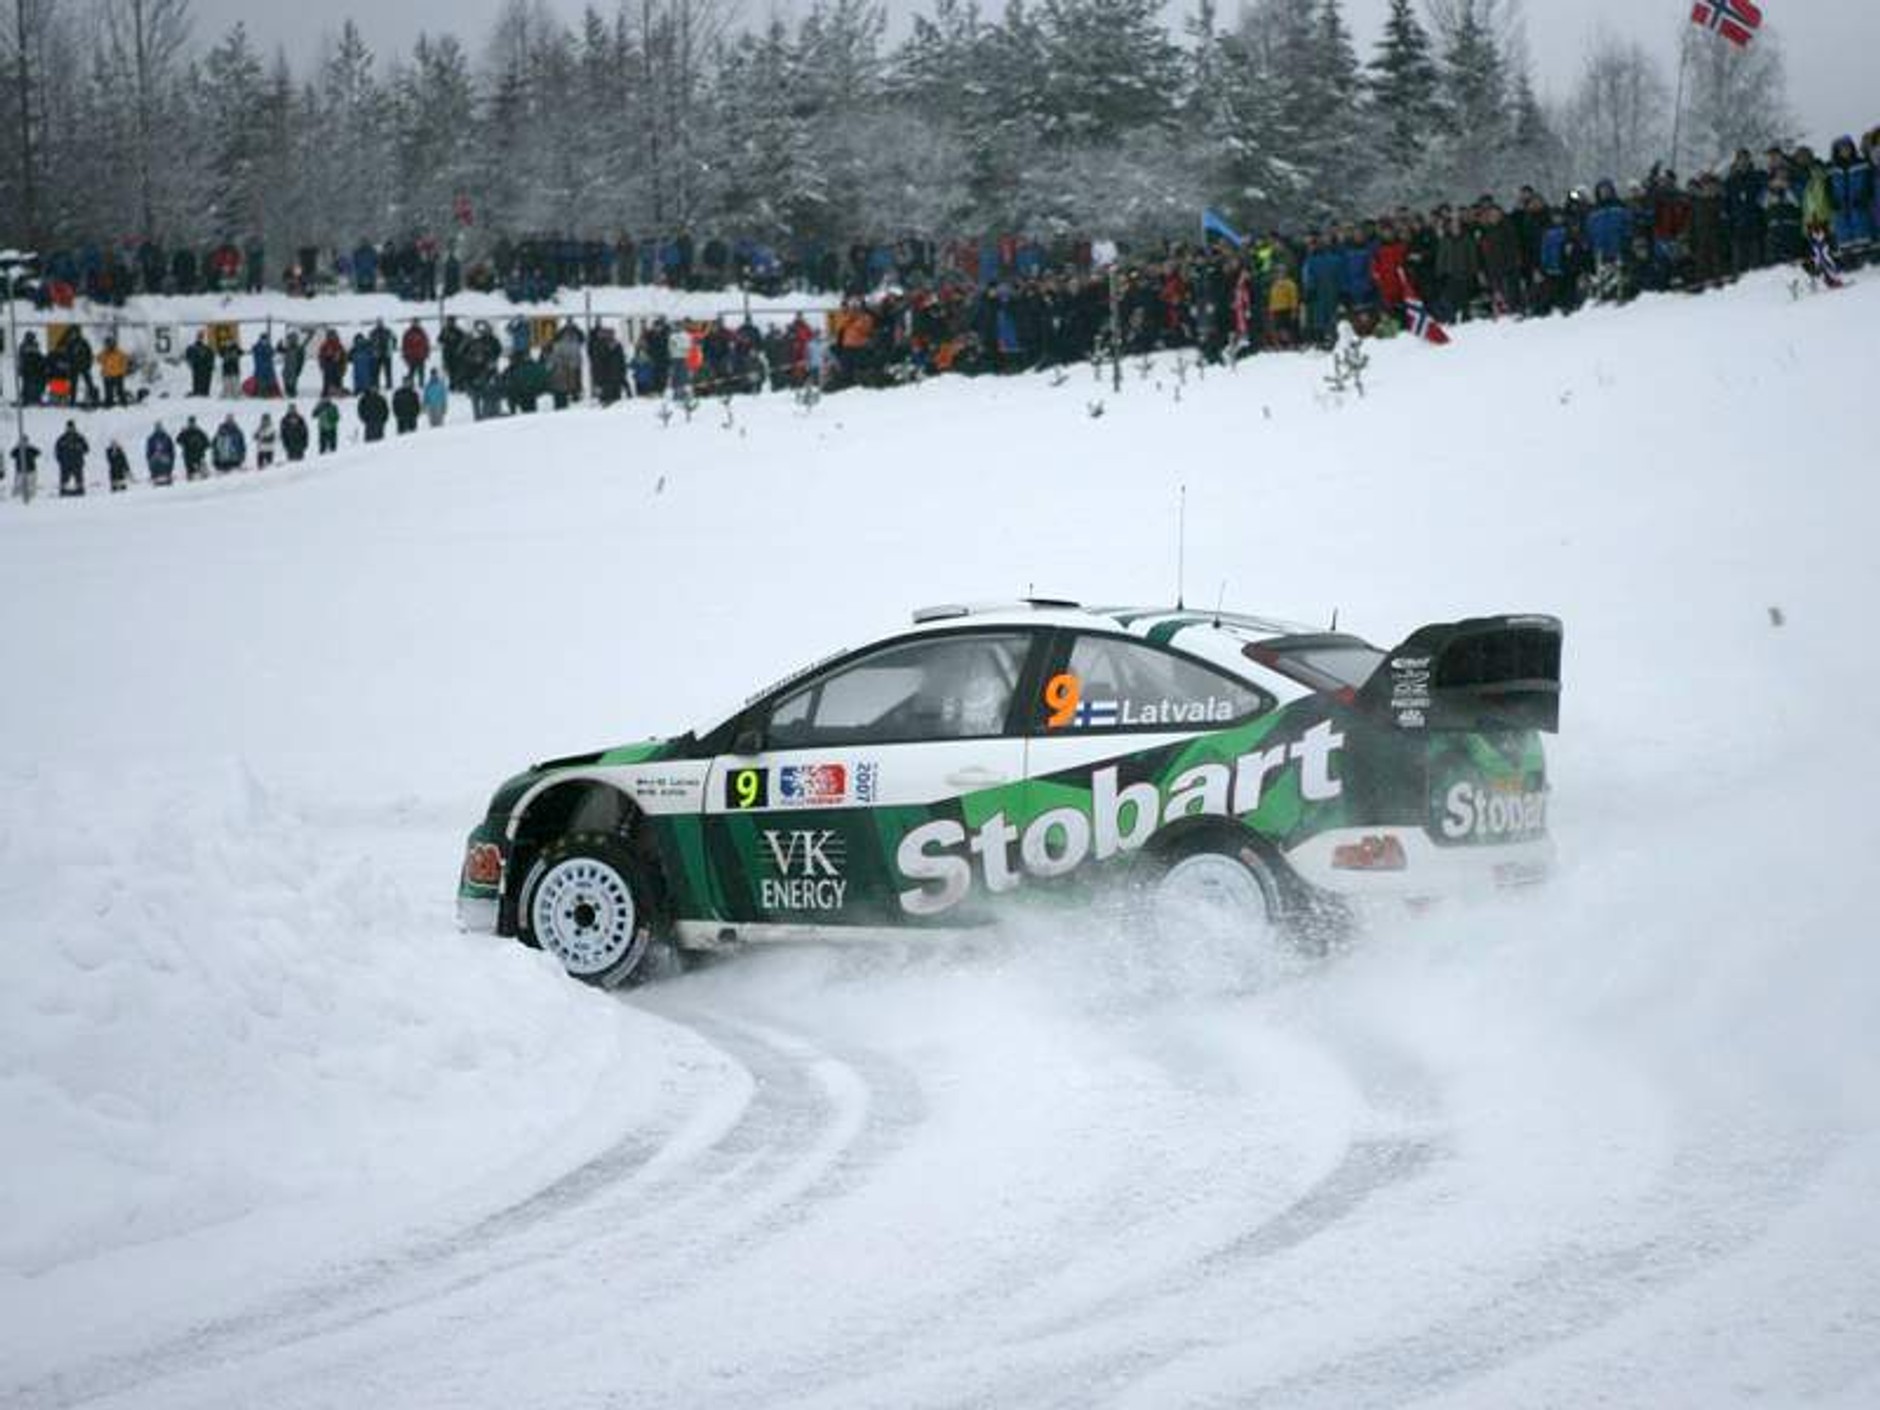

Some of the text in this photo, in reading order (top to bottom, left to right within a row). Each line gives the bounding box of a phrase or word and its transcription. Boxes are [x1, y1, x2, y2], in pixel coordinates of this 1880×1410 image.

[155, 326, 171, 354] 5
[1045, 674, 1233, 727] 9 Latvala
[736, 770, 759, 807] 9
[856, 762, 871, 802] 2007
[897, 720, 1345, 915] Stobart
[763, 830, 840, 876] VK
[762, 879, 847, 909] ENERGY
